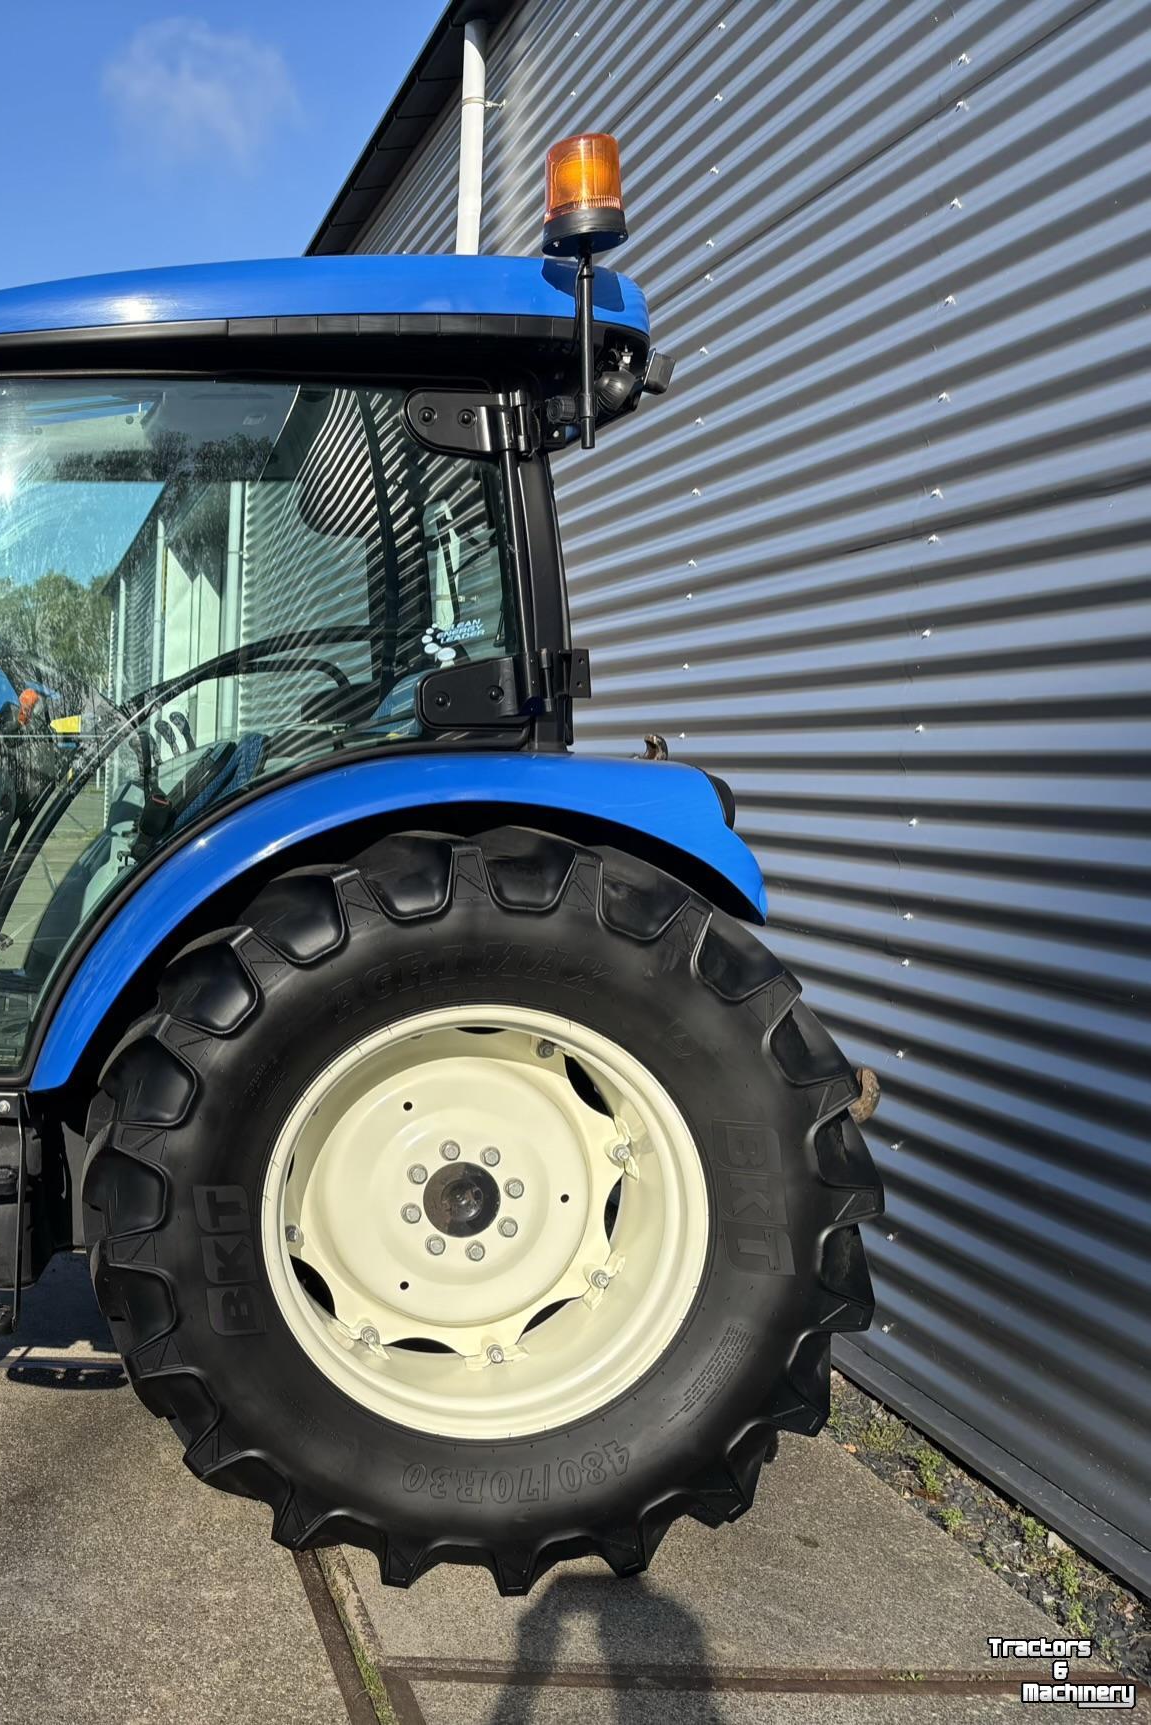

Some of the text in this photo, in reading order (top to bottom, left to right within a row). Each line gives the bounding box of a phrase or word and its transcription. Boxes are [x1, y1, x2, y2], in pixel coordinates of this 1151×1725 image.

[440, 629, 485, 644] LEADER
[717, 1121, 792, 1274] BKT
[197, 1187, 264, 1334] BKT
[402, 1440, 630, 1504] 480/70R30
